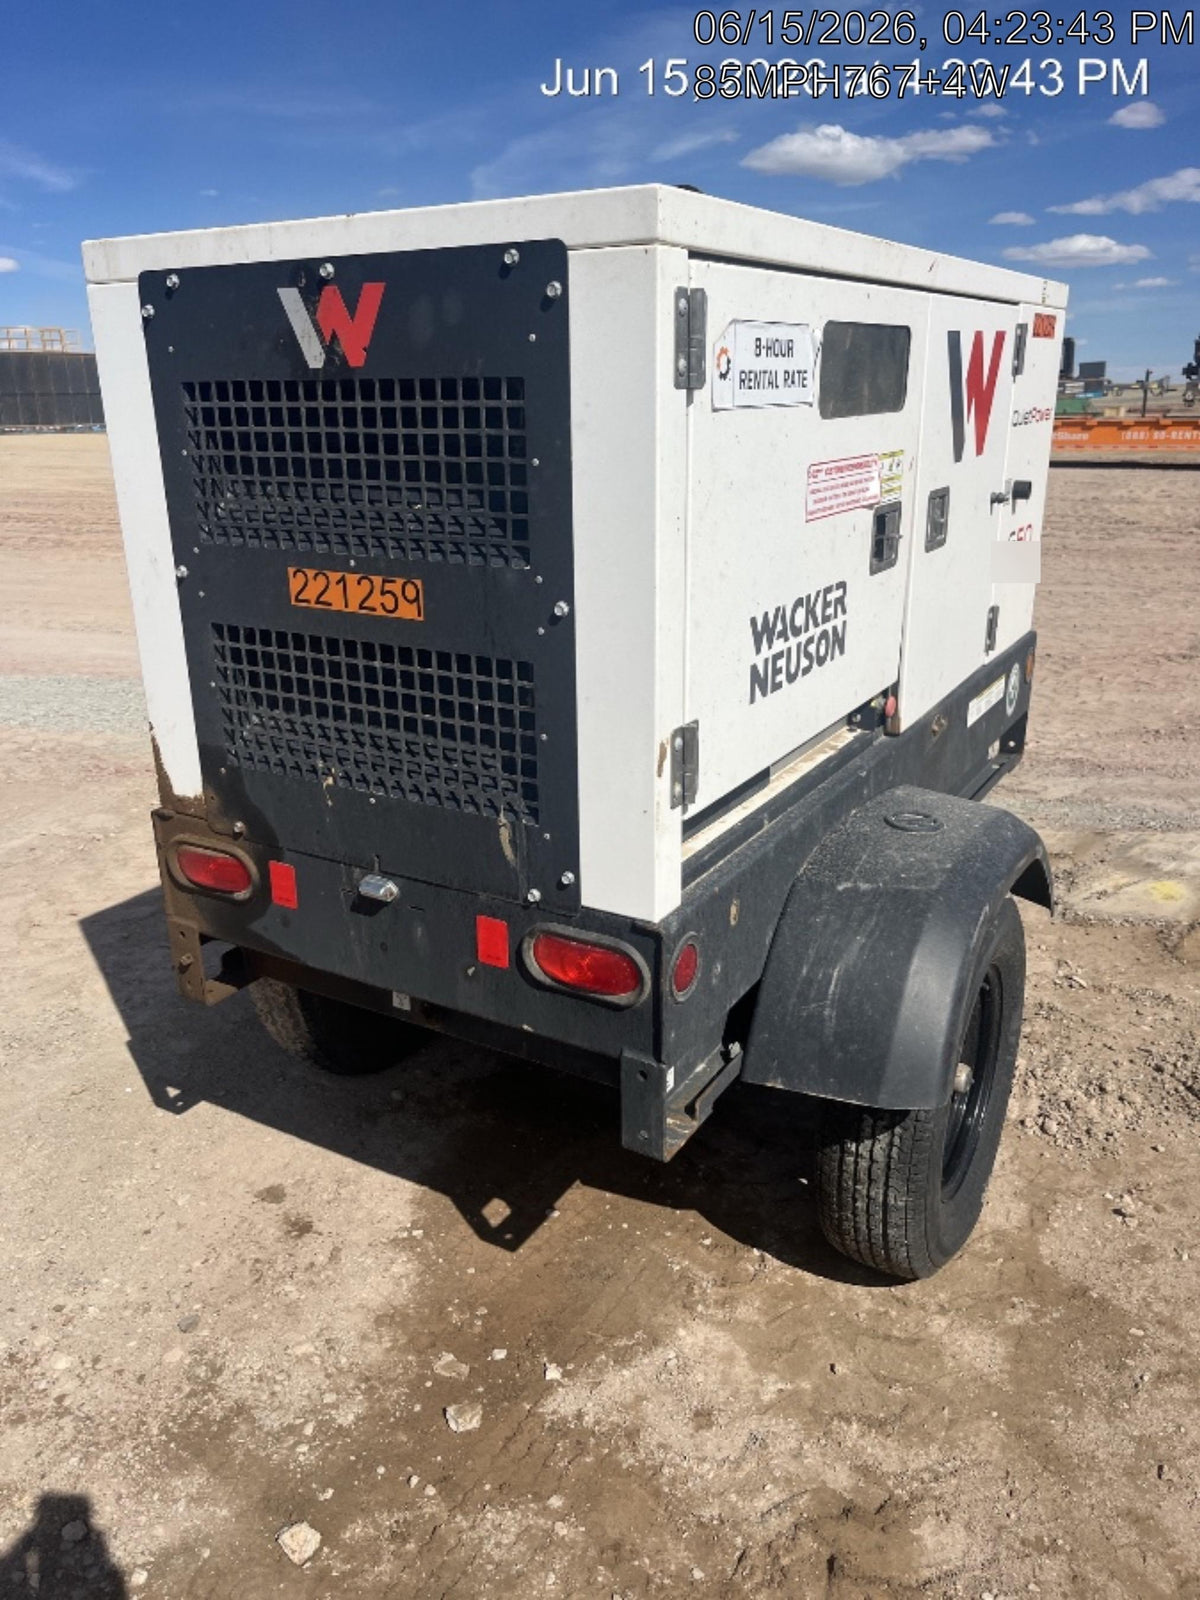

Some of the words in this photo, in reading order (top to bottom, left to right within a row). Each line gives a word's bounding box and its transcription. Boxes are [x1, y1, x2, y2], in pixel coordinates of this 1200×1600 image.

[755, 337, 794, 358] 8-HOUR
[739, 369, 780, 390] RENTAL
[784, 369, 808, 389] RATE
[292, 568, 422, 618] 221259
[750, 580, 847, 656] WACKER
[749, 620, 847, 705] NEUSON
